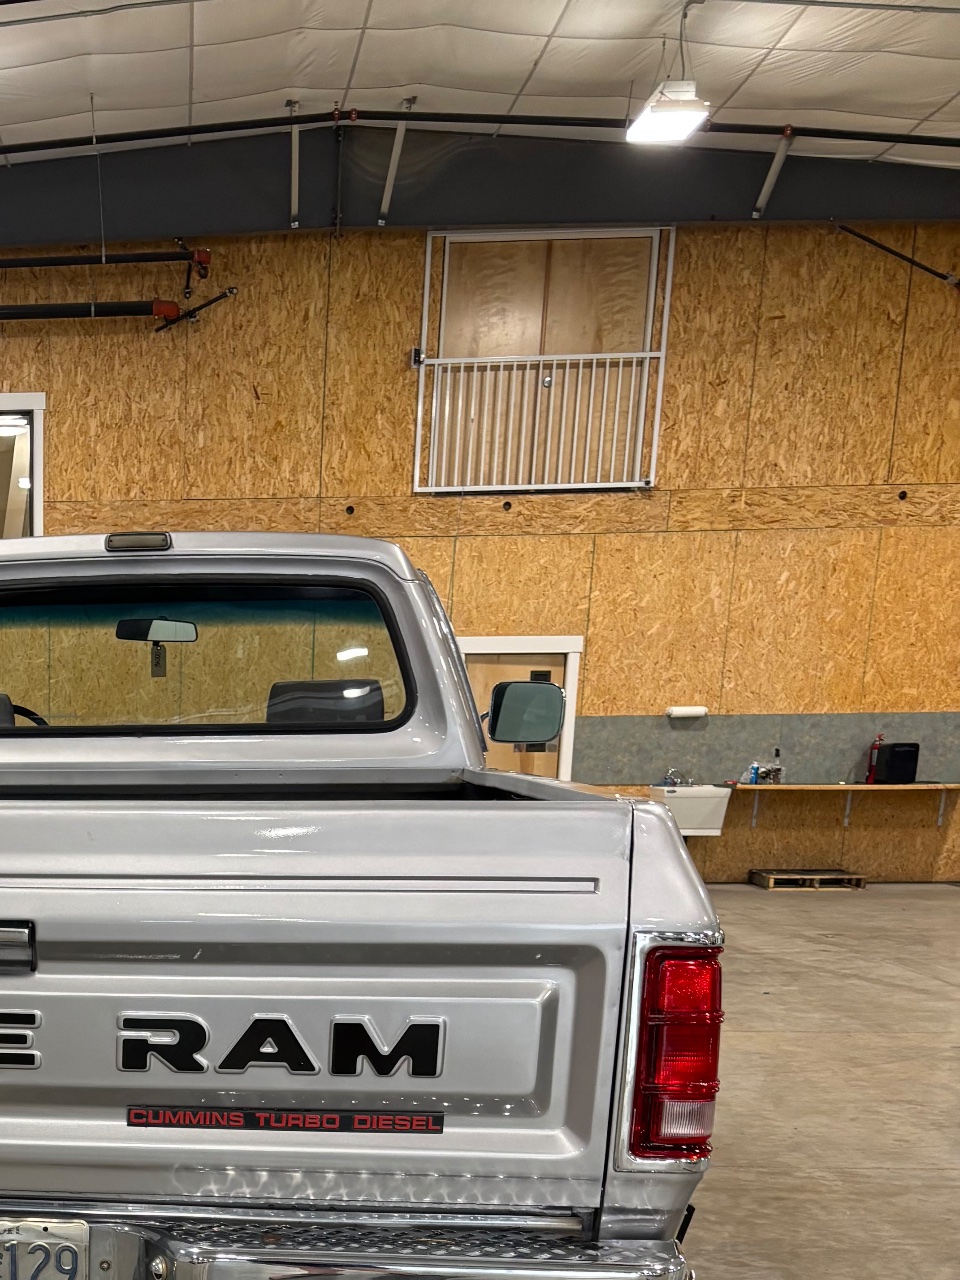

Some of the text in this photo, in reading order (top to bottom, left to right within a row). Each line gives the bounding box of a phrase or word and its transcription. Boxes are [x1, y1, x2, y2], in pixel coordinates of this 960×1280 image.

[116, 1011, 447, 1078] RAM
[129, 1109, 441, 1131] CUMMINS TURBO DIESEL
